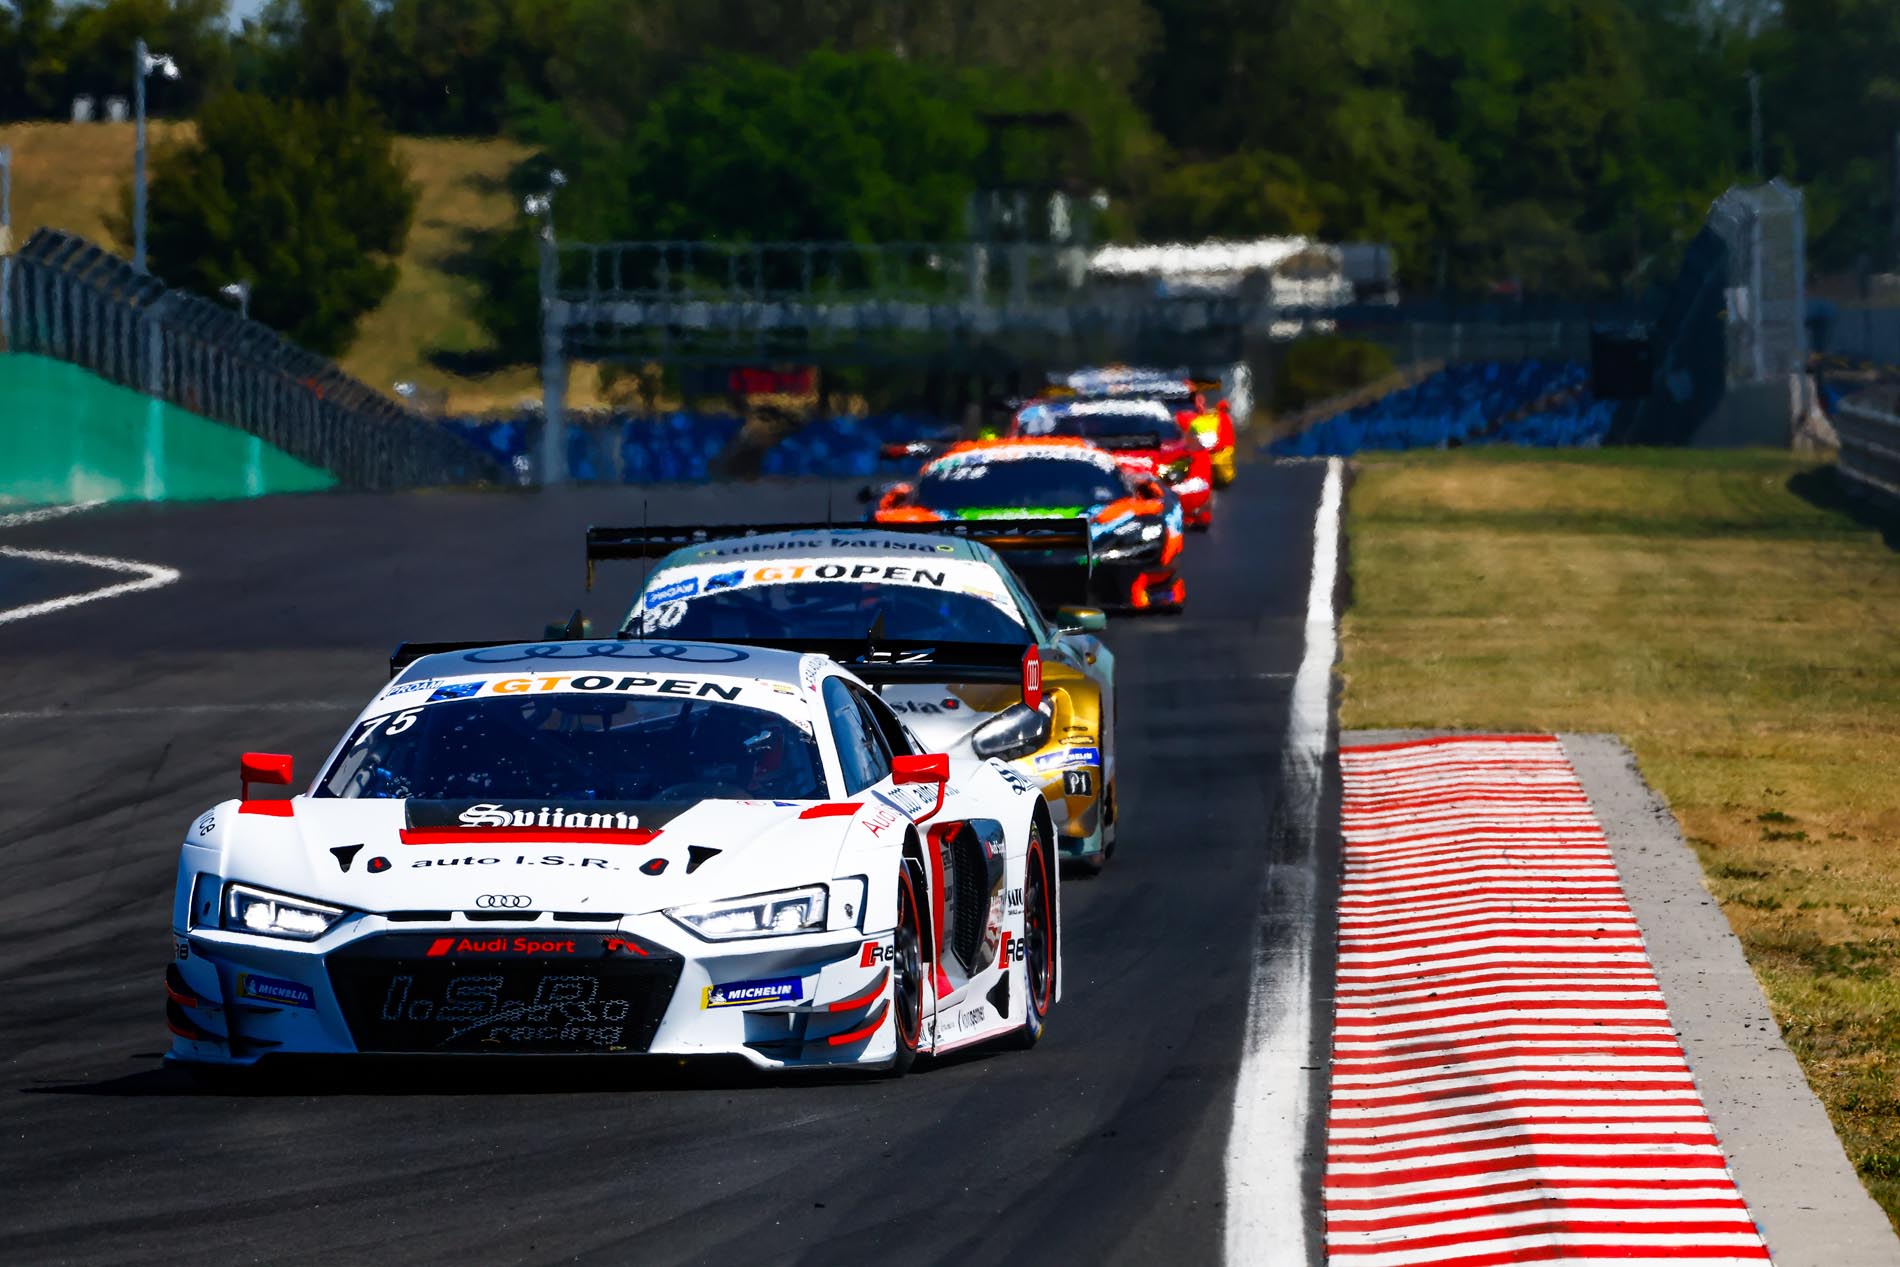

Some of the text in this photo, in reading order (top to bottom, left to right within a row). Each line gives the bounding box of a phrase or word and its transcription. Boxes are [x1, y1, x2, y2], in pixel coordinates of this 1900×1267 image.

[386, 681, 443, 697] PROAM
[356, 707, 425, 744] 75
[411, 856, 620, 870] auto I.S.R.
[456, 937, 576, 955] Audi Sport
[871, 945, 894, 964] R8
[1006, 938, 1024, 962] R8
[258, 983, 309, 1001] MICHELIN
[728, 985, 792, 1000] MICHELIN
